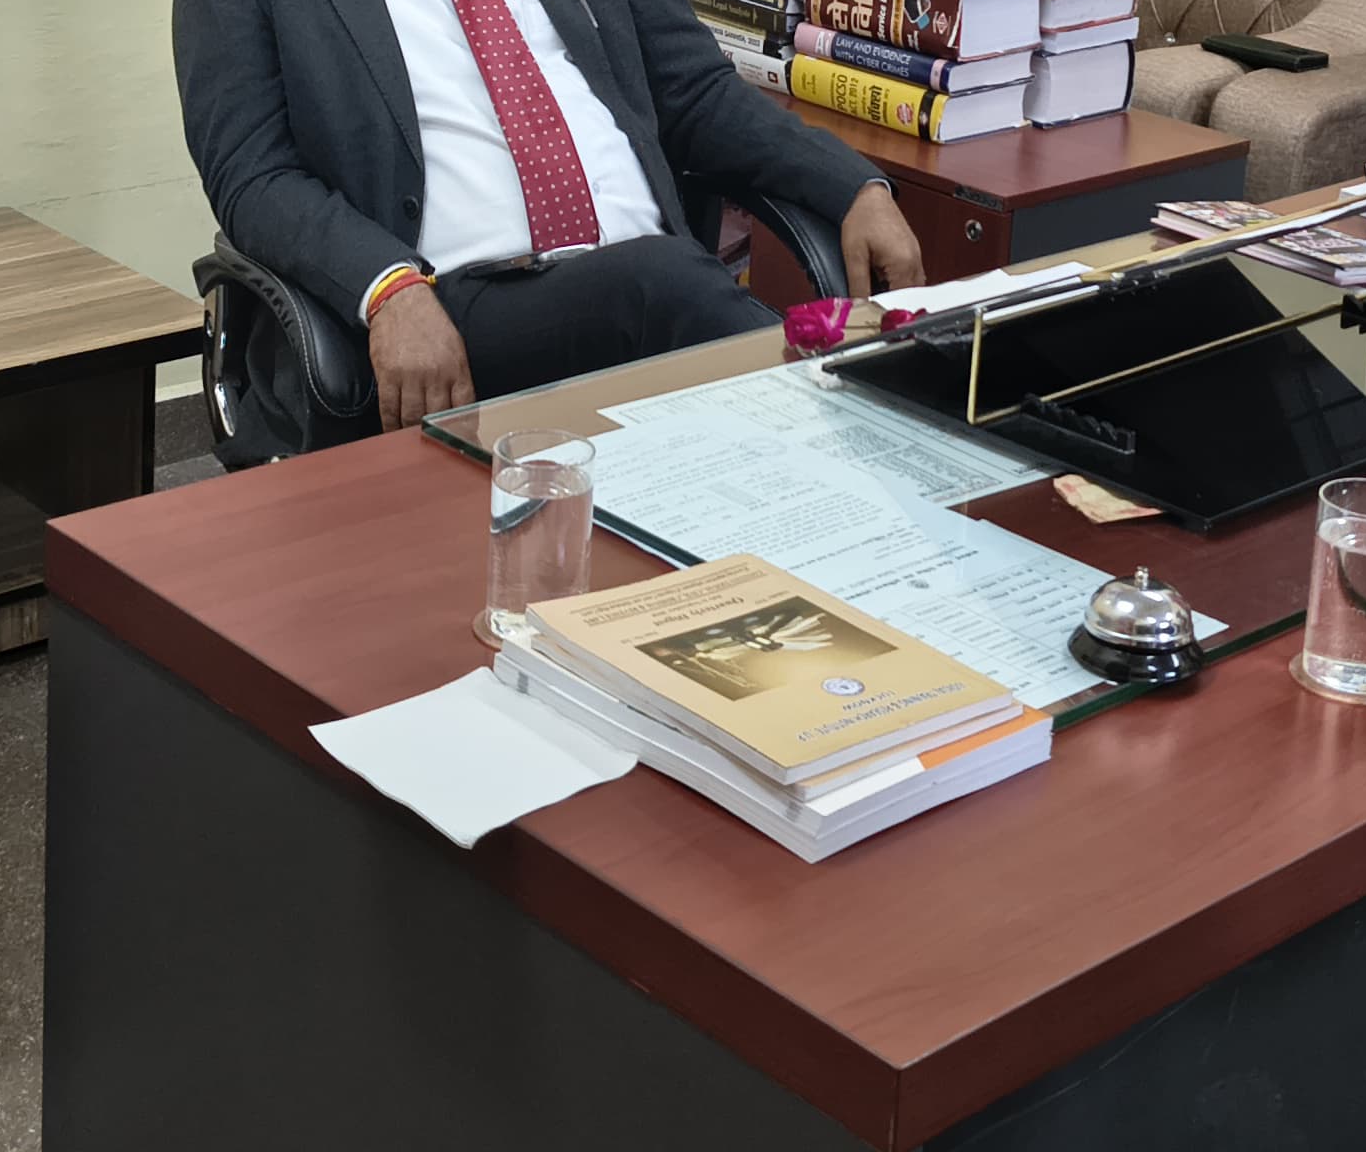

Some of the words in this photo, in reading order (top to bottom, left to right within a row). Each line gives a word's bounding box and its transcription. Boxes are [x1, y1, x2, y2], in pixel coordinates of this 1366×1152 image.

[834, 49, 855, 63] WITH
[856, 53, 880, 68] CYBER
[880, 60, 910, 78] CRIMES
[835, 36, 853, 49] LAW
[853, 42, 872, 56] AND
[872, 45, 912, 66] EVIDENCE
[835, 74, 848, 113] POCSO
